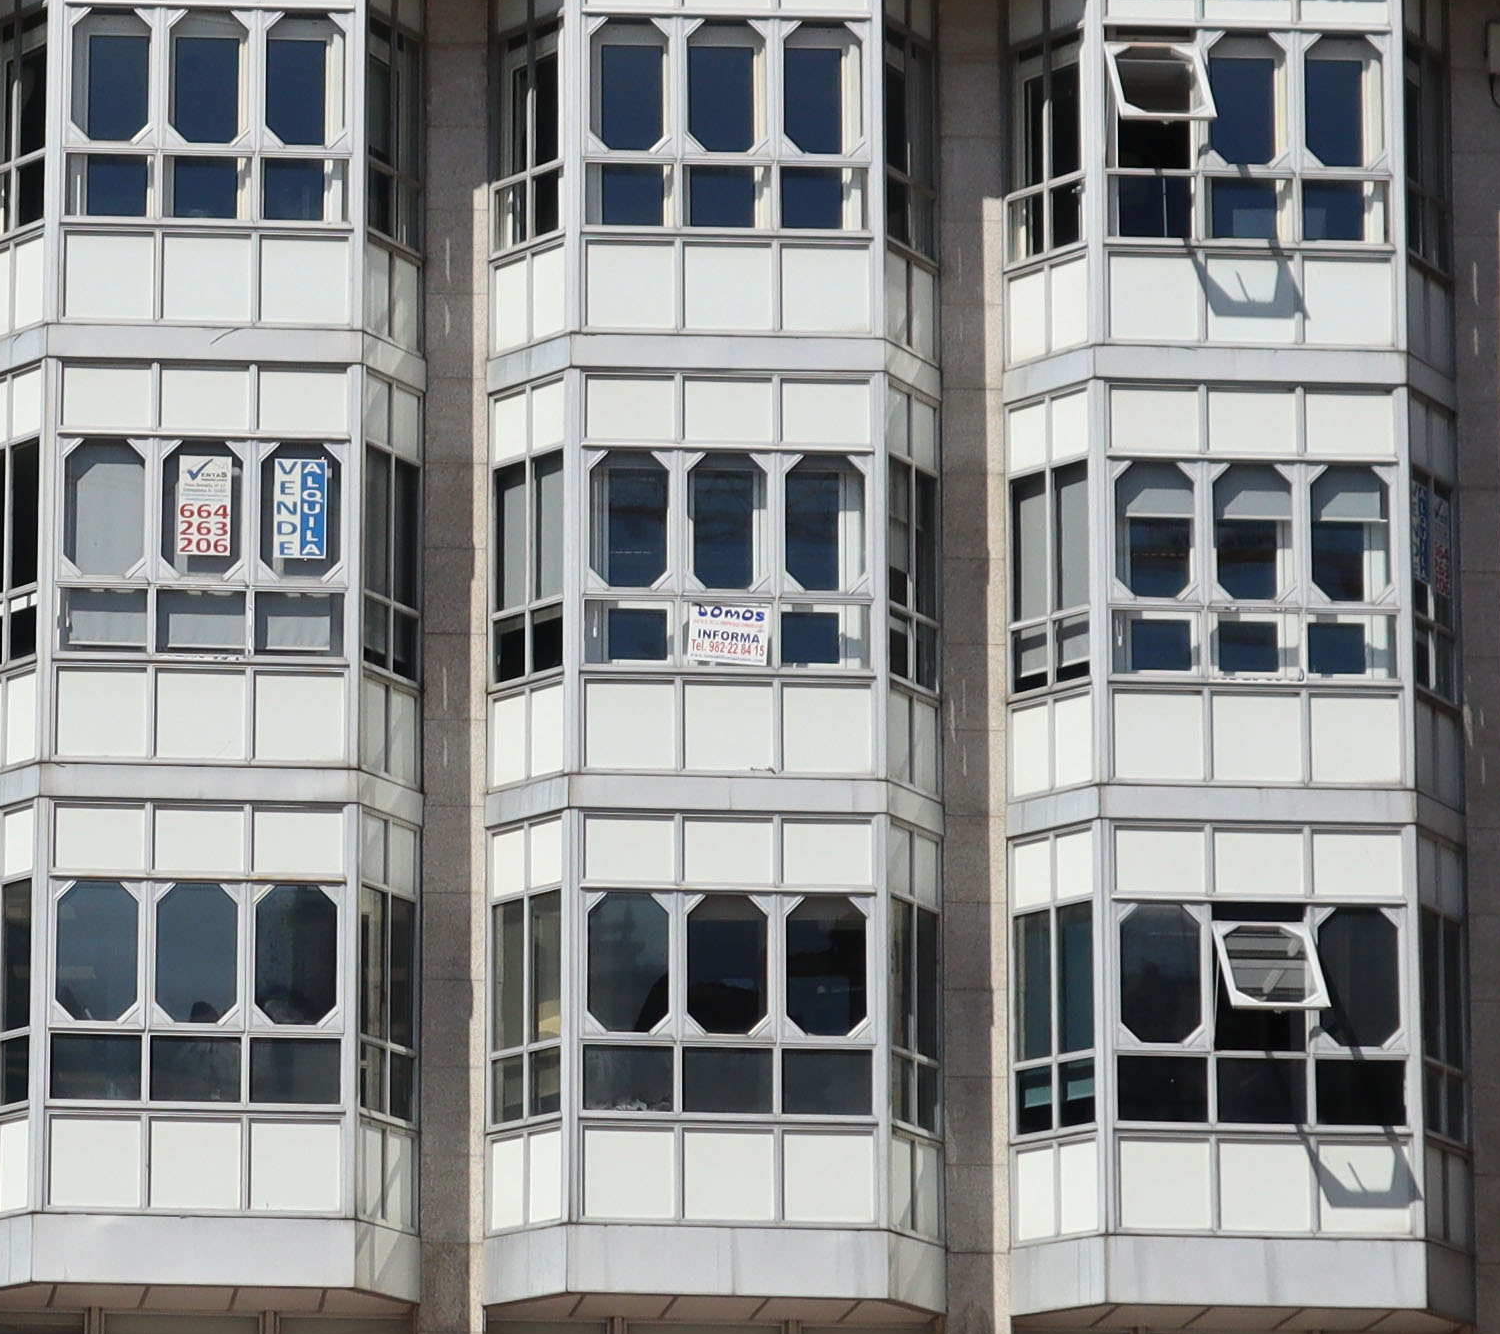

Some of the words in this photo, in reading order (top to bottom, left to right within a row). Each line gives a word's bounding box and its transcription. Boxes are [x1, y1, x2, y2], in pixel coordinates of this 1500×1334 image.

[179, 502, 230, 520] 664
[276, 460, 298, 556] VENDE
[302, 462, 323, 555] ALQUILA
[179, 520, 229, 537] 263
[179, 537, 229, 554] 206
[697, 629, 761, 644] INFORMA
[691, 638, 707, 652] Tel.
[740, 643, 752, 656] 84
[754, 644, 765, 657] 15
